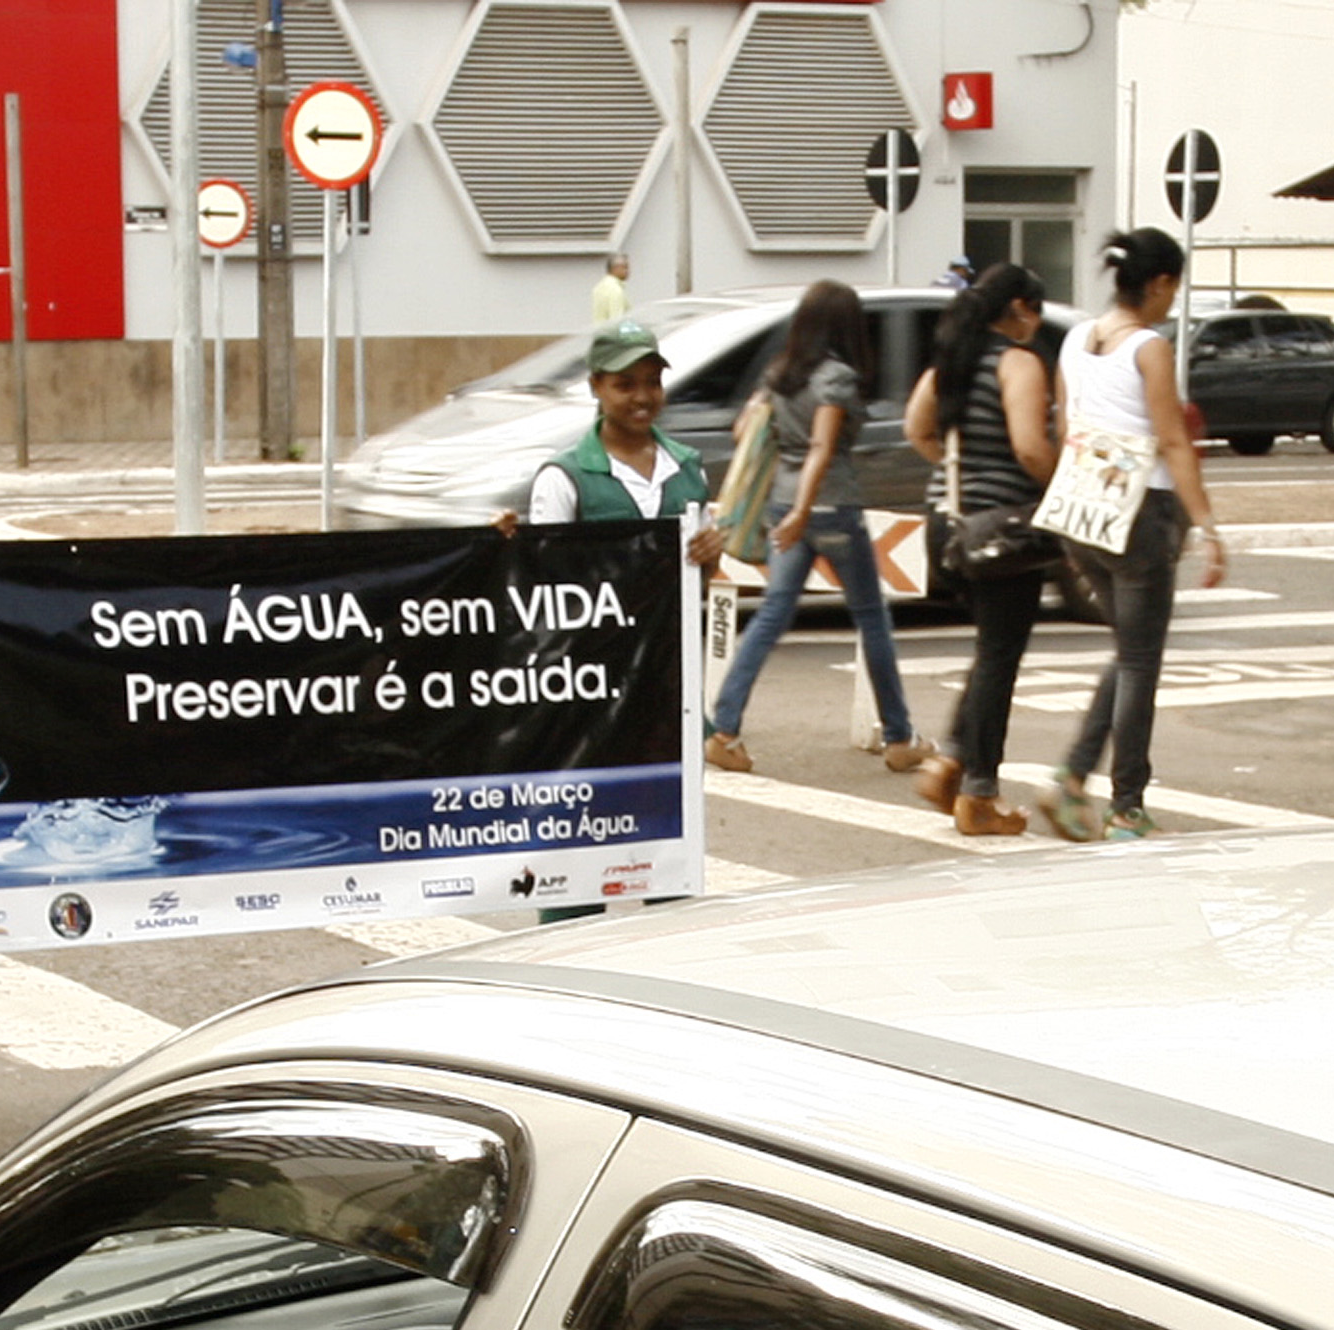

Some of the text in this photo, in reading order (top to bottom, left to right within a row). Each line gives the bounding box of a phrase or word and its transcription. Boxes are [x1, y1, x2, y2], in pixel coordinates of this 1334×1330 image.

[1043, 496, 1120, 545] PINK
[90, 581, 636, 648] Sem ÁGUA, sem VIDA.
[712, 595, 733, 659] Setran
[125, 652, 621, 723] Preservar é a saída.
[431, 781, 594, 813] 22 de Março
[379, 806, 640, 852] Dia Mundial da Água.
[322, 892, 382, 907] CESUMAR
[538, 875, 567, 888] APP
[134, 915, 199, 930] SANEPAR
